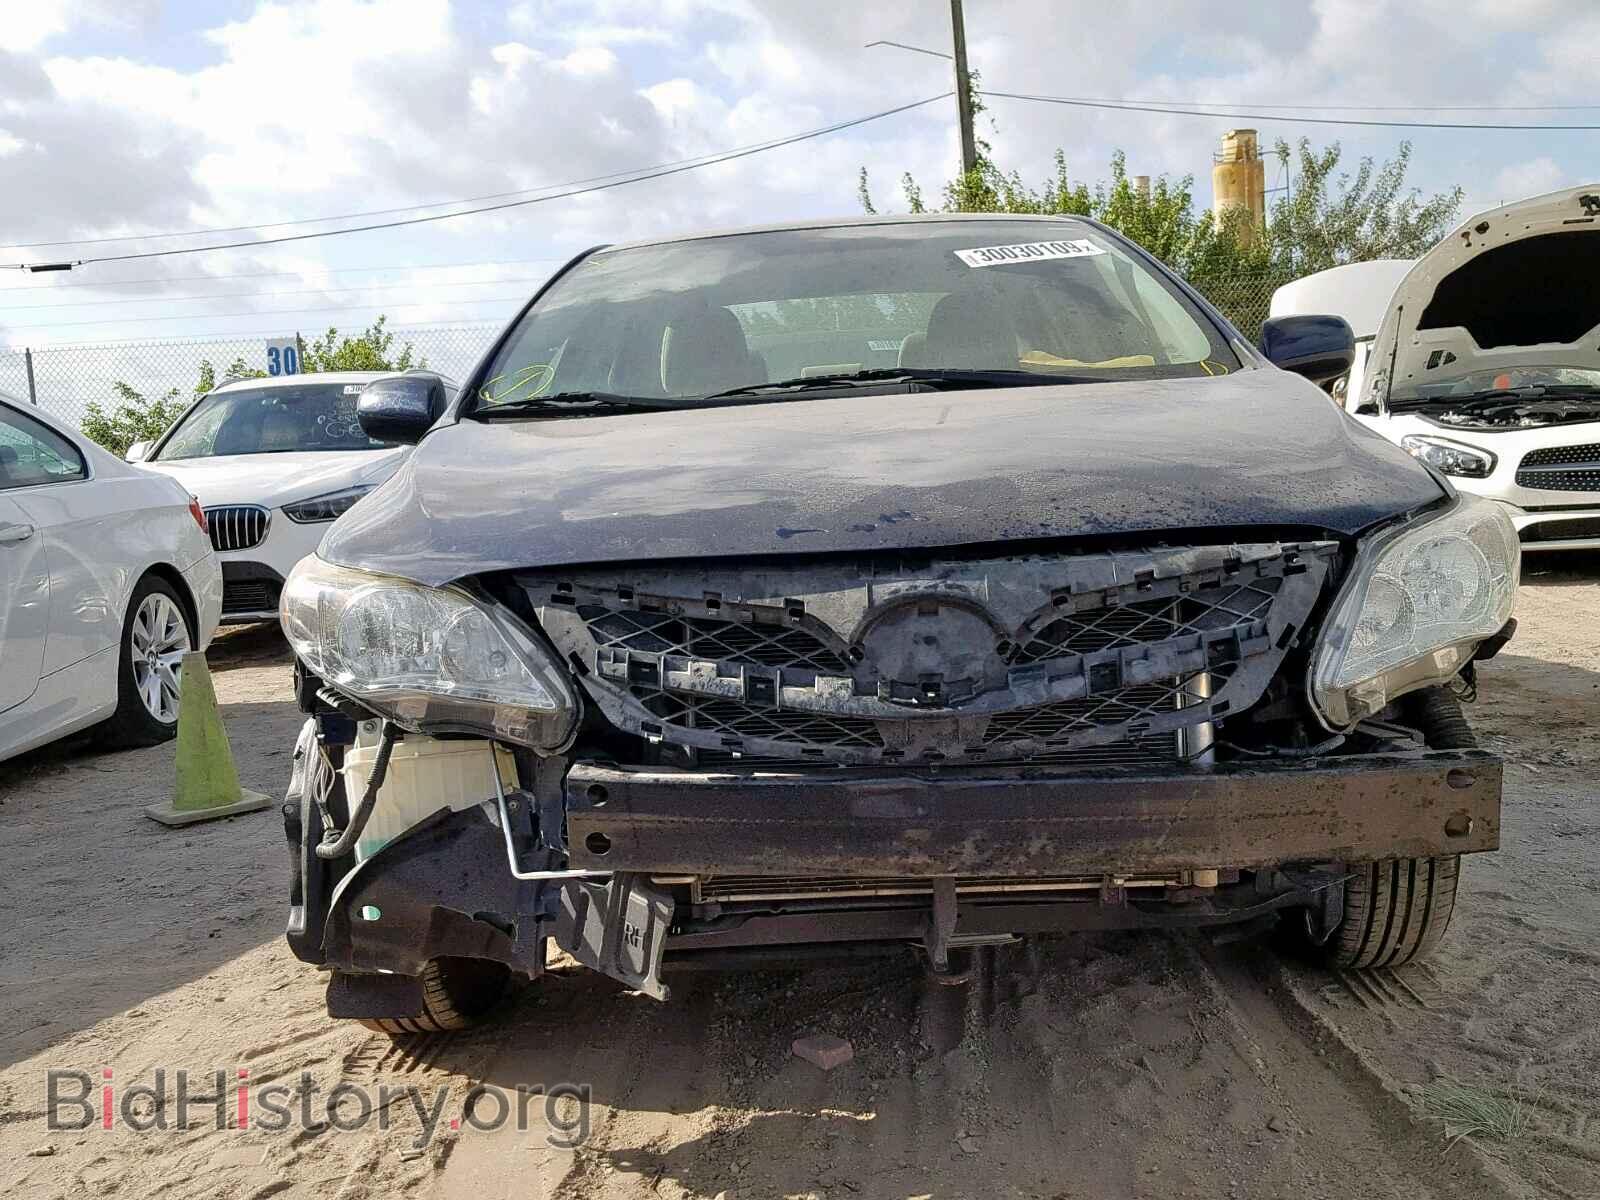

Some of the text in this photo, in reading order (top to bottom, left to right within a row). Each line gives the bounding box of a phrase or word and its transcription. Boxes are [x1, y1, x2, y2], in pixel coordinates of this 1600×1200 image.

[973, 241, 1082, 263] 30030109
[267, 346, 297, 376] 30
[624, 921, 646, 952] RH
